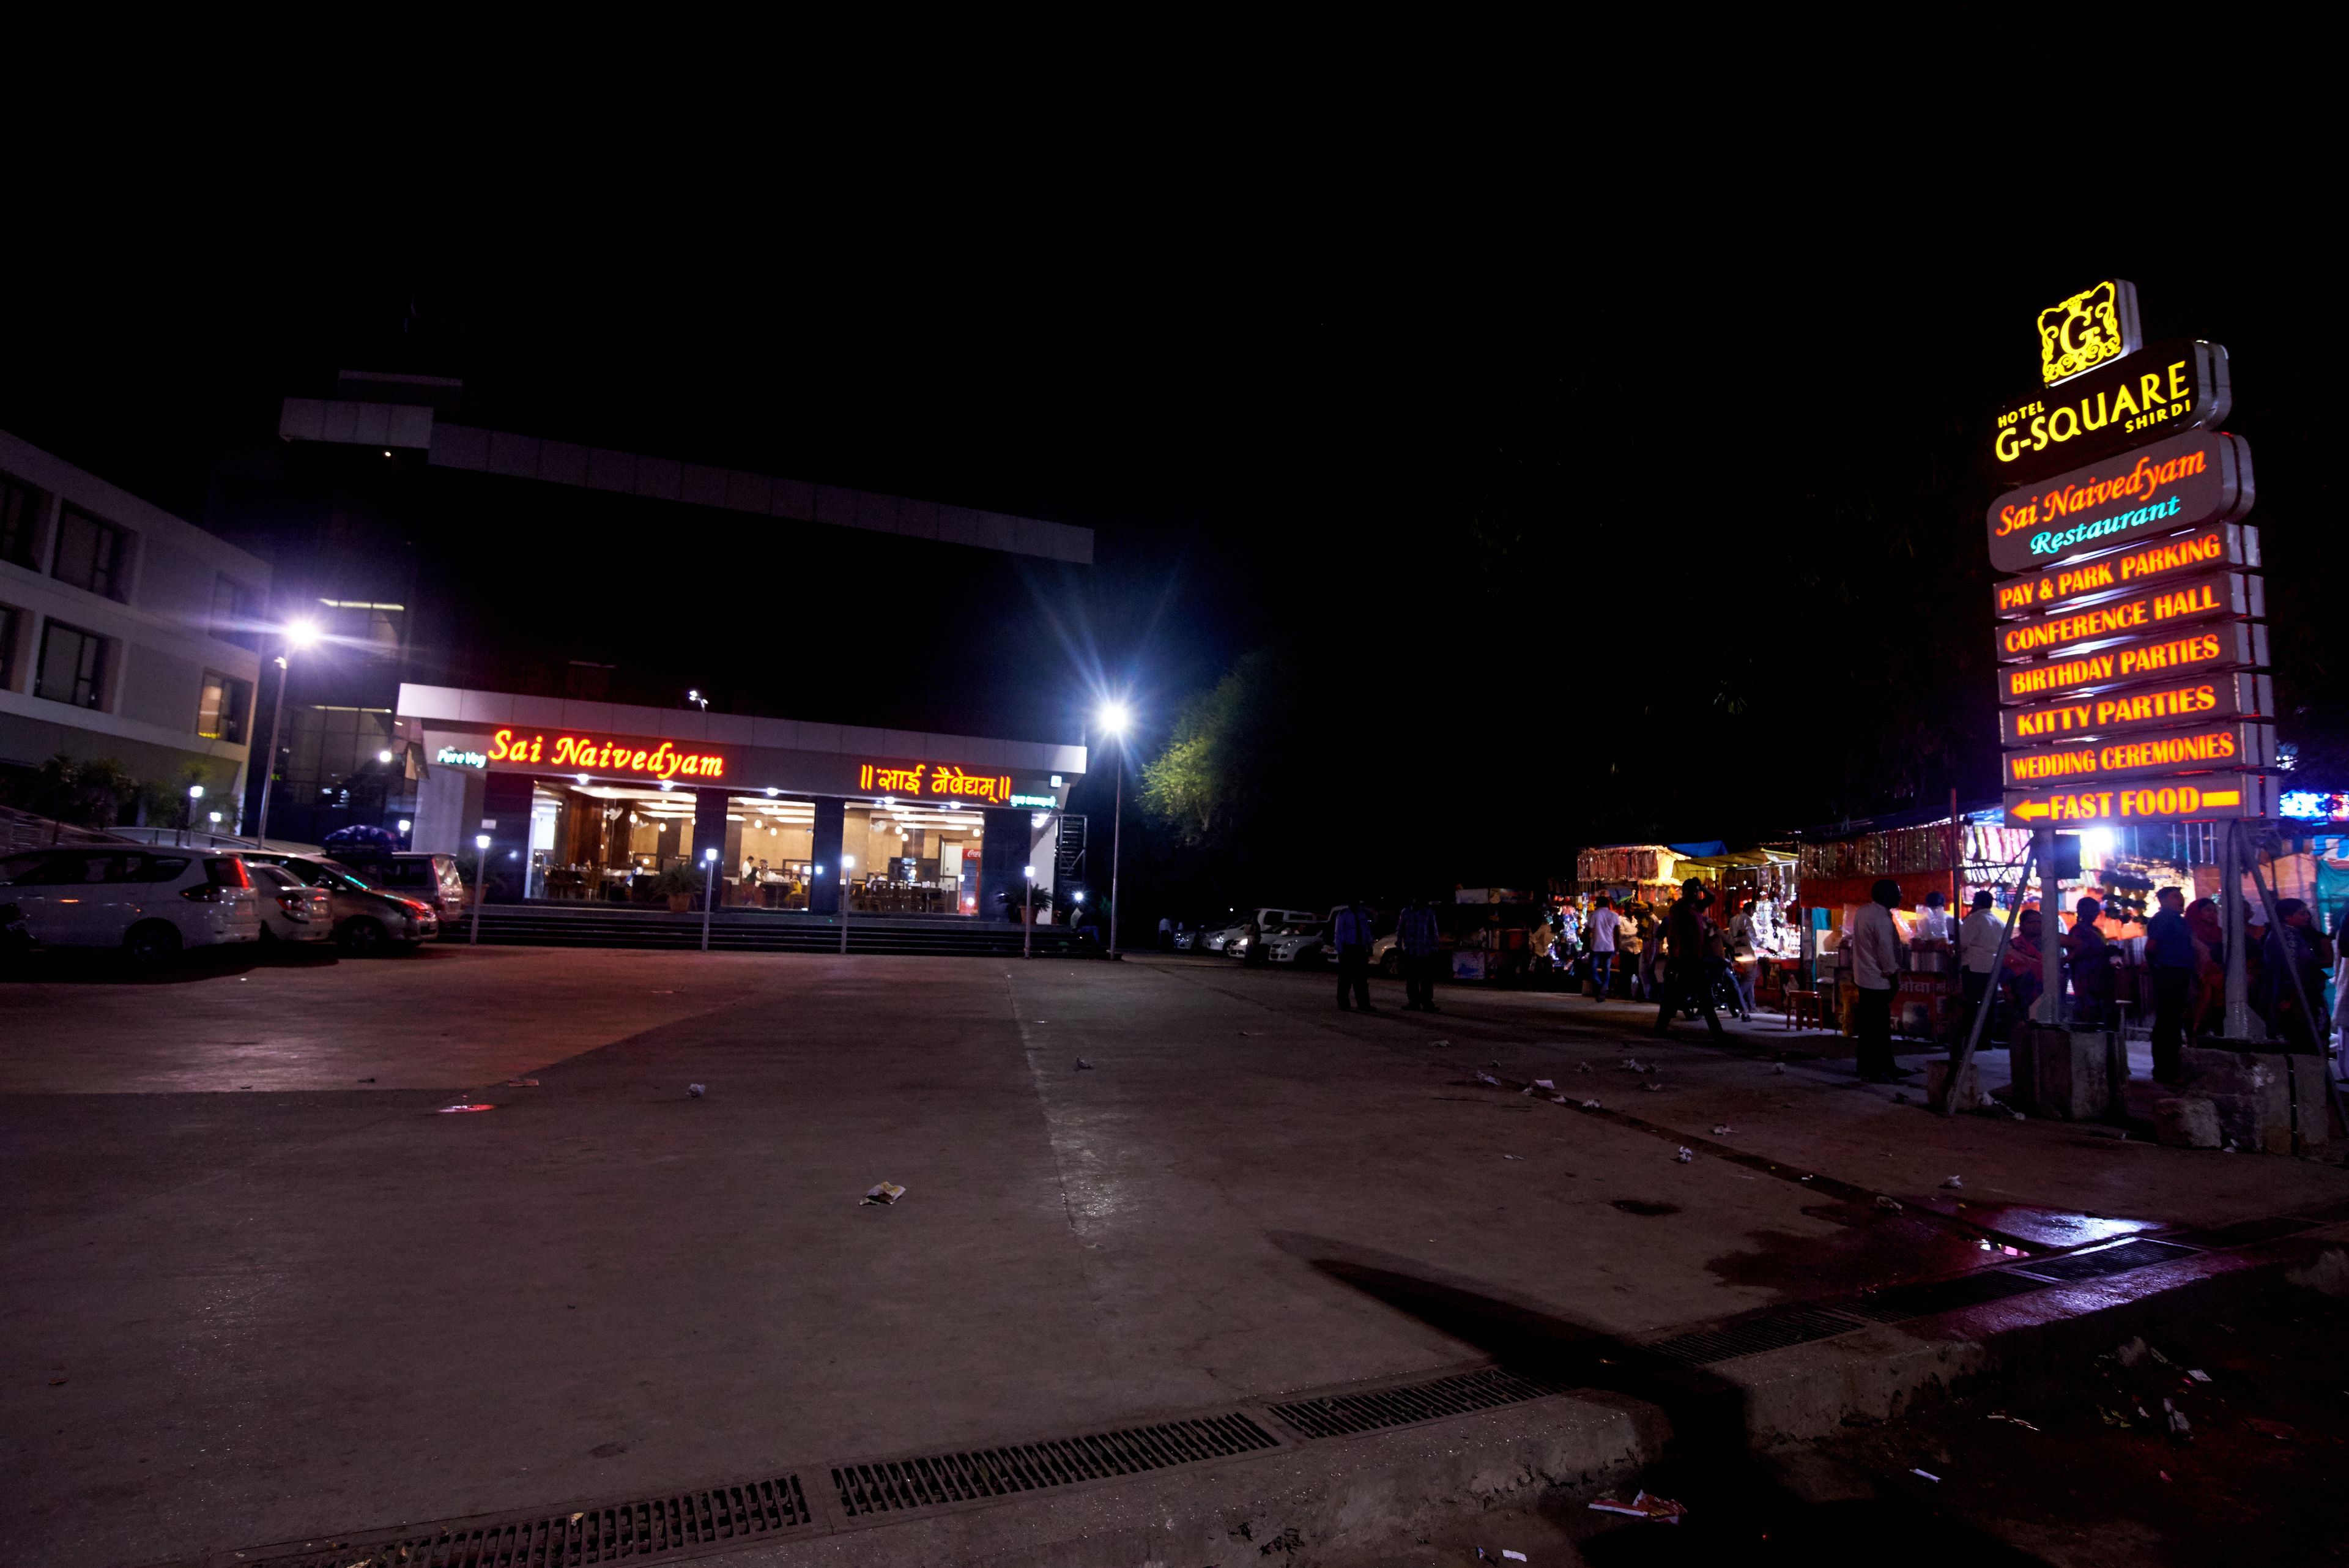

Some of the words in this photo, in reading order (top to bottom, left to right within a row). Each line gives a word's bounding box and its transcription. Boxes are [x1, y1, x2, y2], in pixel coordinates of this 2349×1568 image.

[1995, 360, 2189, 462] G-SQUARE
[1998, 401, 2045, 428] HOTEL
[2124, 399, 2191, 433] SHIRDI
[1995, 496, 2039, 537] Sai
[2043, 450, 2207, 522] Naivedyam
[2030, 496, 2181, 555] Restaurant
[1999, 582, 2034, 610] PAY
[2038, 579, 2055, 601] &
[2057, 562, 2115, 596] PARK
[2120, 533, 2222, 581] PARKING
[2004, 600, 2149, 653] CONFERENCE
[2153, 585, 2221, 620] HALL
[2010, 654, 2115, 696] BIRTHDAY
[2119, 634, 2221, 675] PARTIES
[2016, 704, 2092, 737] KITTY
[2096, 685, 2217, 725] PARTIES
[488, 729, 543, 762] Sai
[551, 737, 723, 779] Naivedyam
[2011, 749, 2098, 780] WEDDING
[2099, 732, 2235, 771] CEREMONIES
[2049, 791, 2115, 821] FAST
[2119, 786, 2202, 818] FOOD
